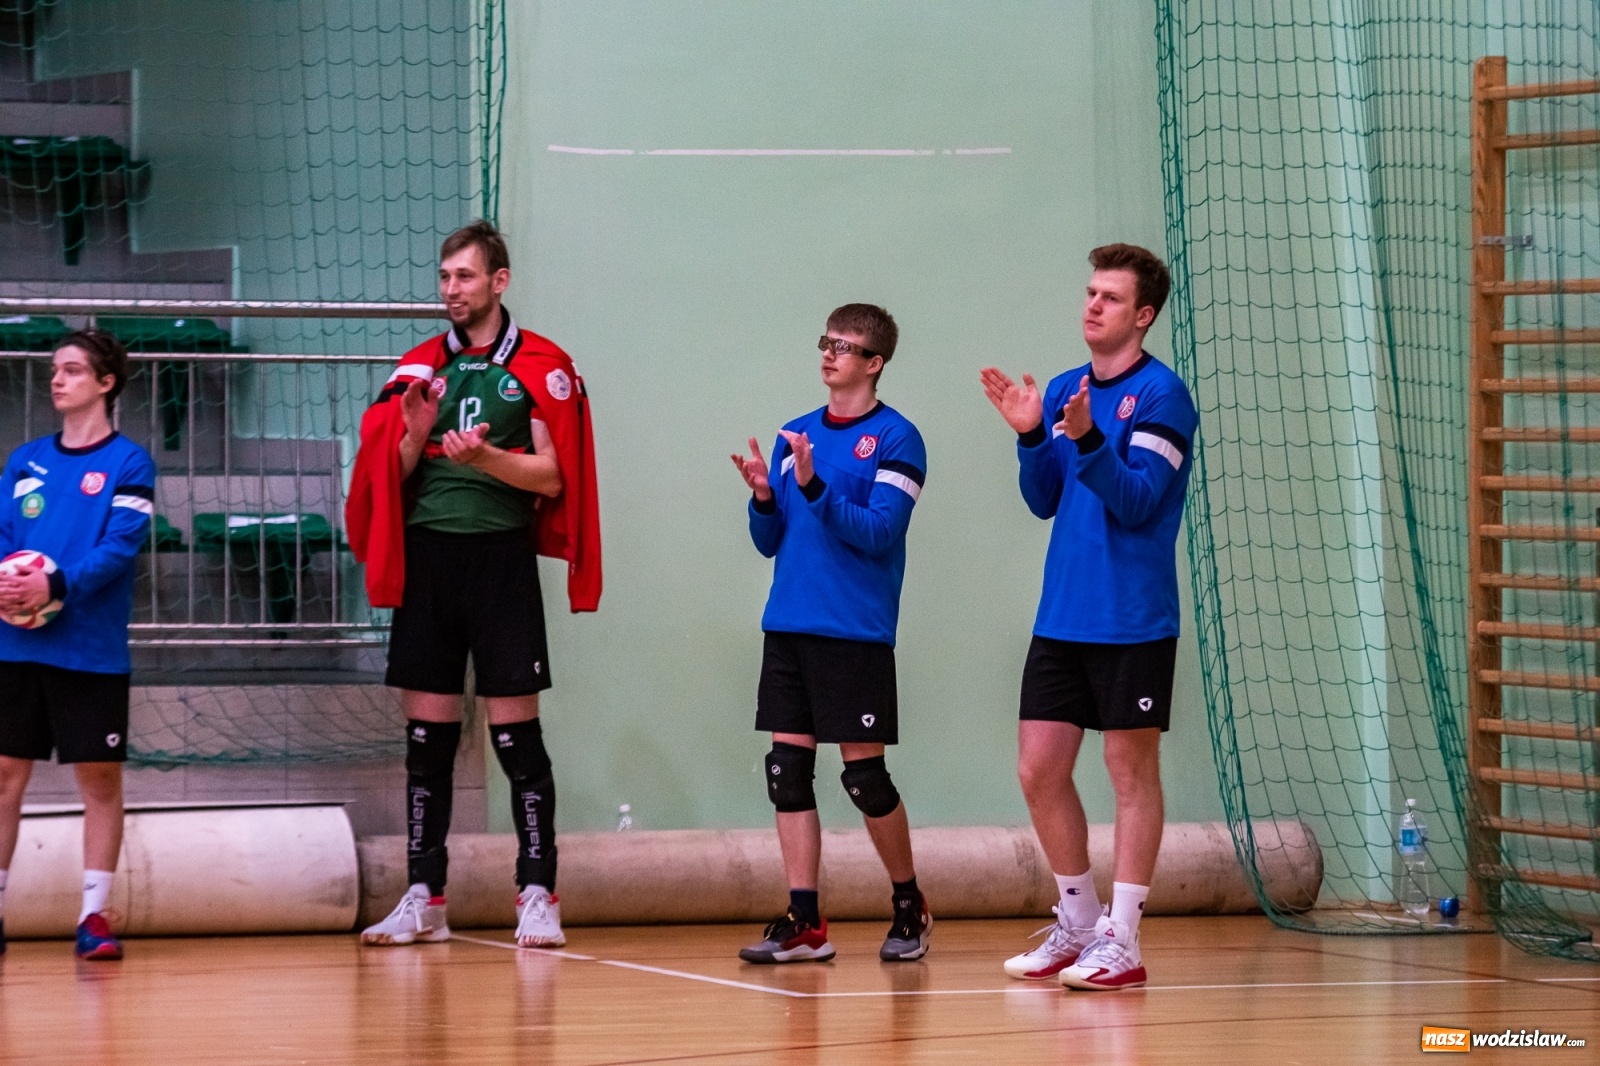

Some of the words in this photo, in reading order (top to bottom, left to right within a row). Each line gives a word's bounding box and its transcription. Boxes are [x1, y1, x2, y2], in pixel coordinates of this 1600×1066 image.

[459, 397, 482, 432] 12
[409, 786, 431, 851] Kalenji
[521, 791, 542, 859] Kalenji
